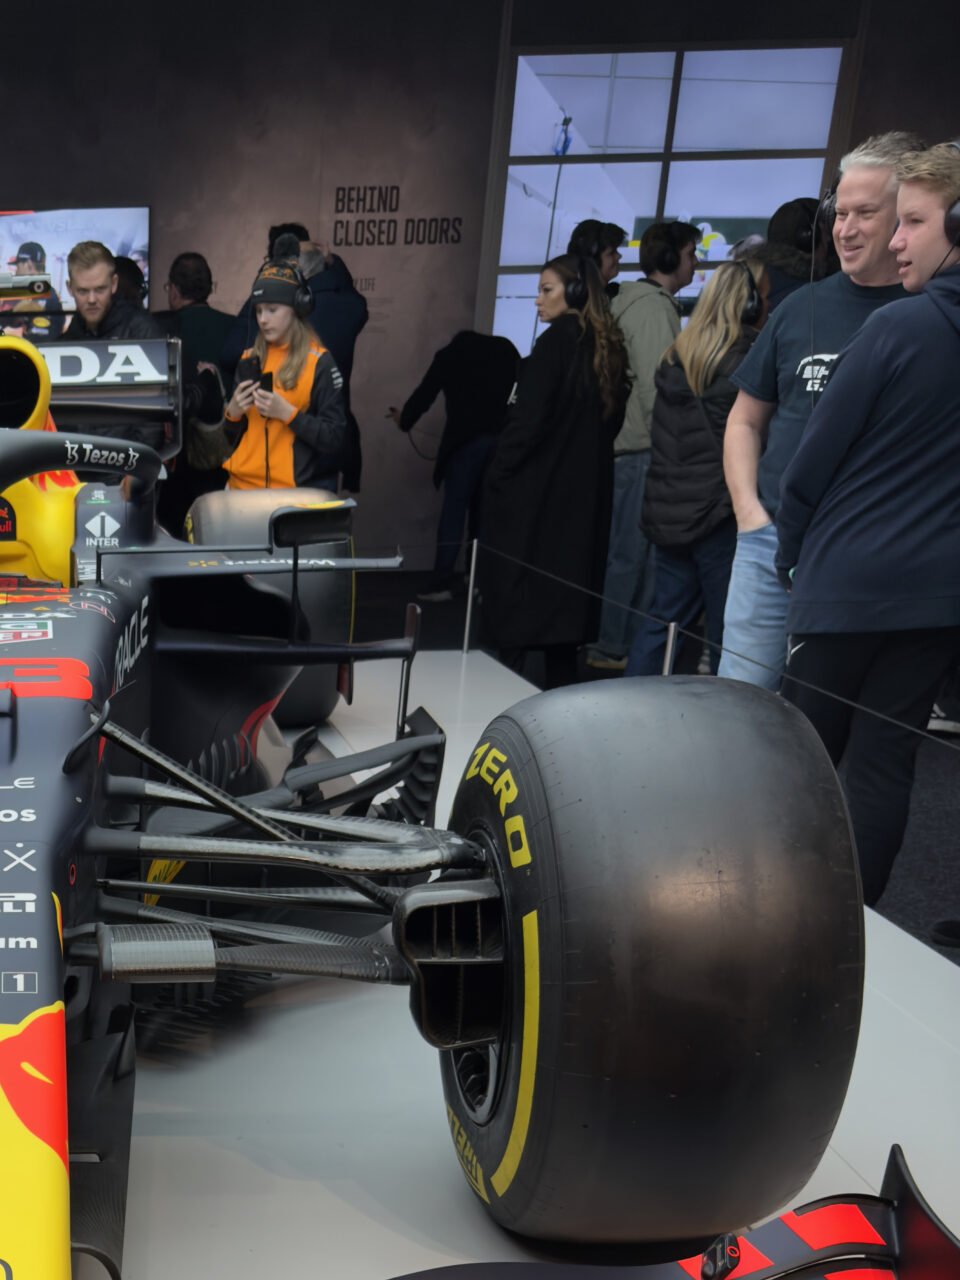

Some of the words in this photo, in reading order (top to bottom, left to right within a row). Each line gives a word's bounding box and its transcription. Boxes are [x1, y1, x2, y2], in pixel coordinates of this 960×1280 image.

[334, 185, 400, 214] BEHIND
[333, 219, 398, 247] CLOSED
[404, 217, 463, 245] DOORS
[82, 443, 125, 466] Tezos
[85, 537, 120, 547] INTER
[465, 742, 532, 869] ZERO
[446, 1102, 490, 1206] PIRELL
